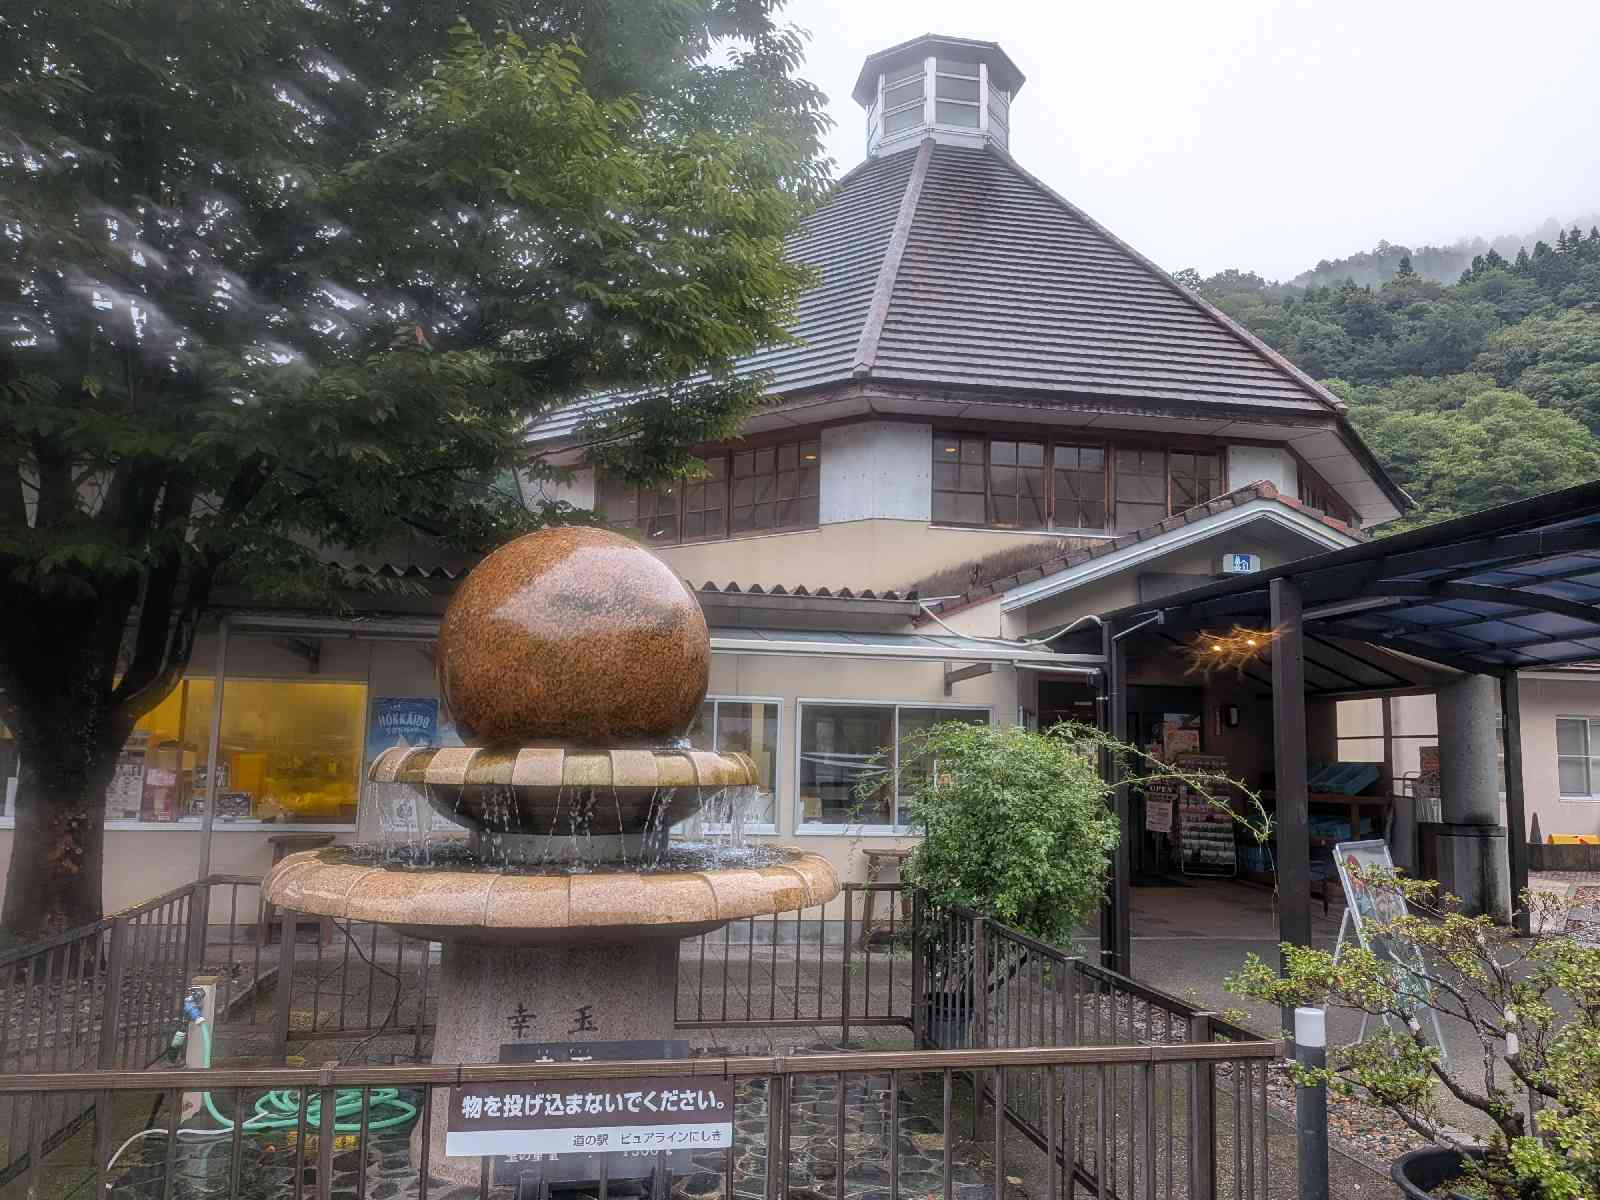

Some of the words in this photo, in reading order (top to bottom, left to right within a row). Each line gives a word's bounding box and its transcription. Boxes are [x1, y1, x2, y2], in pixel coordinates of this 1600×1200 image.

[462, 1089, 725, 1119] 物を投げ込まないでください。
[573, 1133, 609, 1147] 道の駅
[621, 1129, 722, 1145] ピュアラインにしき
